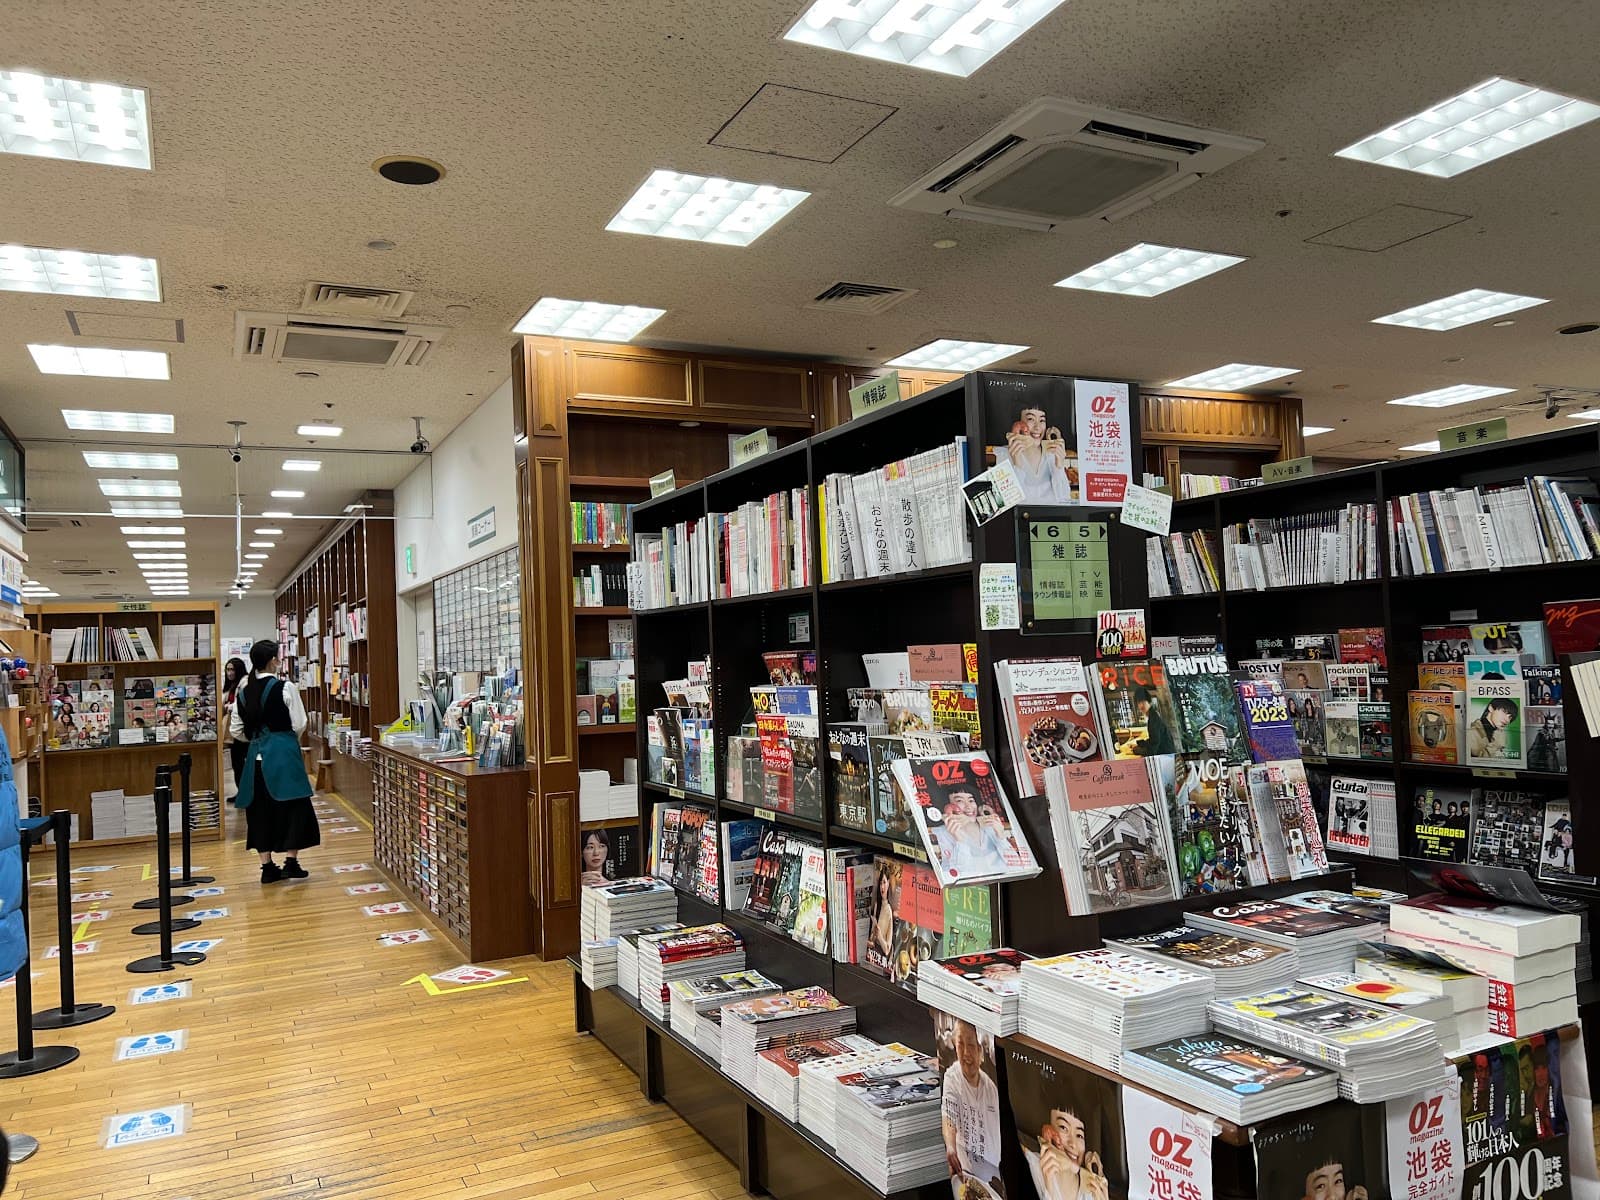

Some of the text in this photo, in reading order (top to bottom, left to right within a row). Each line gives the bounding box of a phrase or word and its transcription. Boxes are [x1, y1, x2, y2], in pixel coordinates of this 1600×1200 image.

[862, 383, 887, 408] 情報誌
[1091, 396, 1116, 414] OZ
[1089, 420, 1120, 439] 池袋
[1456, 427, 1487, 443] 音楽
[1088, 439, 1122, 449] 完全ガイド
[845, 511, 855, 542] dancyu
[901, 498, 917, 568] 散歩の達人
[1047, 525, 1090, 538] 6 5
[871, 505, 891, 573] おとなの週末
[1478, 515, 1497, 567] MUSICA
[1052, 544, 1088, 559] 雑誌
[1080, 570, 1101, 578] TV
[1039, 581, 1065, 590] 情報誌
[1079, 580, 1103, 589] 芸能
[1034, 590, 1072, 599] タウン情報誌
[1080, 590, 1104, 598] 映画
[1101, 632, 1122, 647] 100
[1124, 629, 1145, 644] 日本人
[1472, 625, 1507, 640] CUT
[1255, 638, 1284, 648] 音楽の友
[1294, 636, 1325, 649] BASS
[1012, 667, 1078, 679] サロン・デュ・ショコラ
[1164, 656, 1228, 676] BRUTUS
[1240, 663, 1281, 674] MOSTLY
[1327, 666, 1368, 674] rockin'on
[1467, 660, 1517, 676] PMC
[1522, 668, 1553, 678] Talking
[851, 698, 875, 712] dancyu
[886, 690, 929, 708] BRUTUS
[1250, 707, 1288, 723] 2023
[829, 730, 866, 747] おとなの週末
[914, 737, 933, 750] TRY
[931, 760, 964, 779] OZ
[1189, 758, 1230, 781] MOE
[909, 774, 932, 807] 池袋
[936, 778, 967, 787] magazine
[838, 802, 867, 825] 東京駅
[1329, 829, 1369, 848] REVOLVER
[1415, 824, 1466, 839] ELLEGARDEN
[762, 831, 785, 855] Casa
[911, 876, 941, 896] Premium
[1212, 902, 1281, 919] Casa
[959, 954, 993, 965] OZ
[1203, 946, 1272, 967] 東京駅
[1496, 983, 1508, 1008] 会社
[1497, 1010, 1510, 1033] 会社
[1156, 1037, 1223, 1057] Tokyo
[1408, 1095, 1444, 1135] OZ
[1409, 1127, 1445, 1145] magazine
[1466, 1118, 1503, 1146] 101人の
[1149, 1126, 1193, 1168] OZ
[1467, 1131, 1520, 1163] 輝ける日本人
[1151, 1153, 1194, 1179] magazine
[1406, 1138, 1453, 1182] 池袋
[1543, 1156, 1562, 1174] 周年
[1479, 1148, 1545, 1200] 100
[1543, 1173, 1564, 1192] 記念
[1407, 1171, 1454, 1200] 完全ガイド
